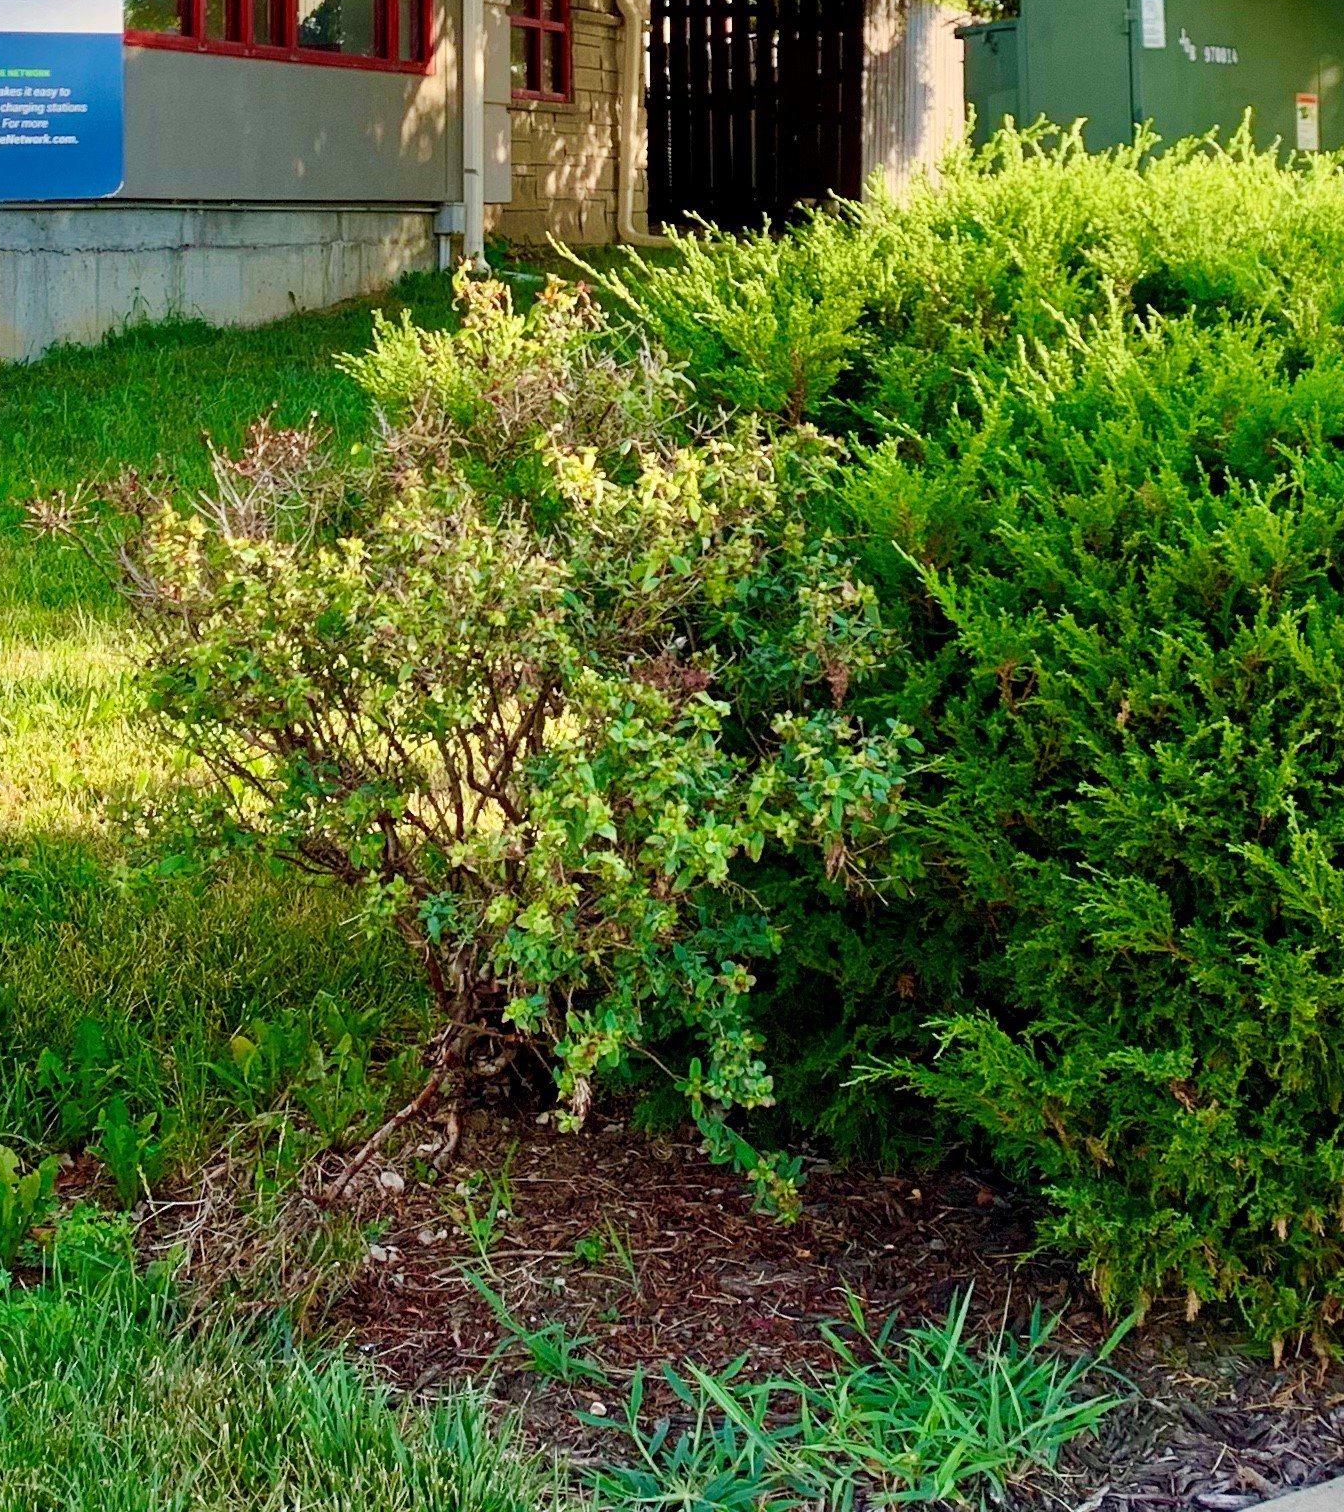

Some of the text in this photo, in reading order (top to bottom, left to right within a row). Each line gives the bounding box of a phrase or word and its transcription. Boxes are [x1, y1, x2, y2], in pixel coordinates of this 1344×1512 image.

[23, 86, 33, 97] it
[33, 88, 57, 99] easy
[58, 87, 71, 97] to
[0, 102, 45, 115] charging
[46, 103, 88, 113] stations
[1, 118, 20, 128] For
[20, 119, 49, 128] more
